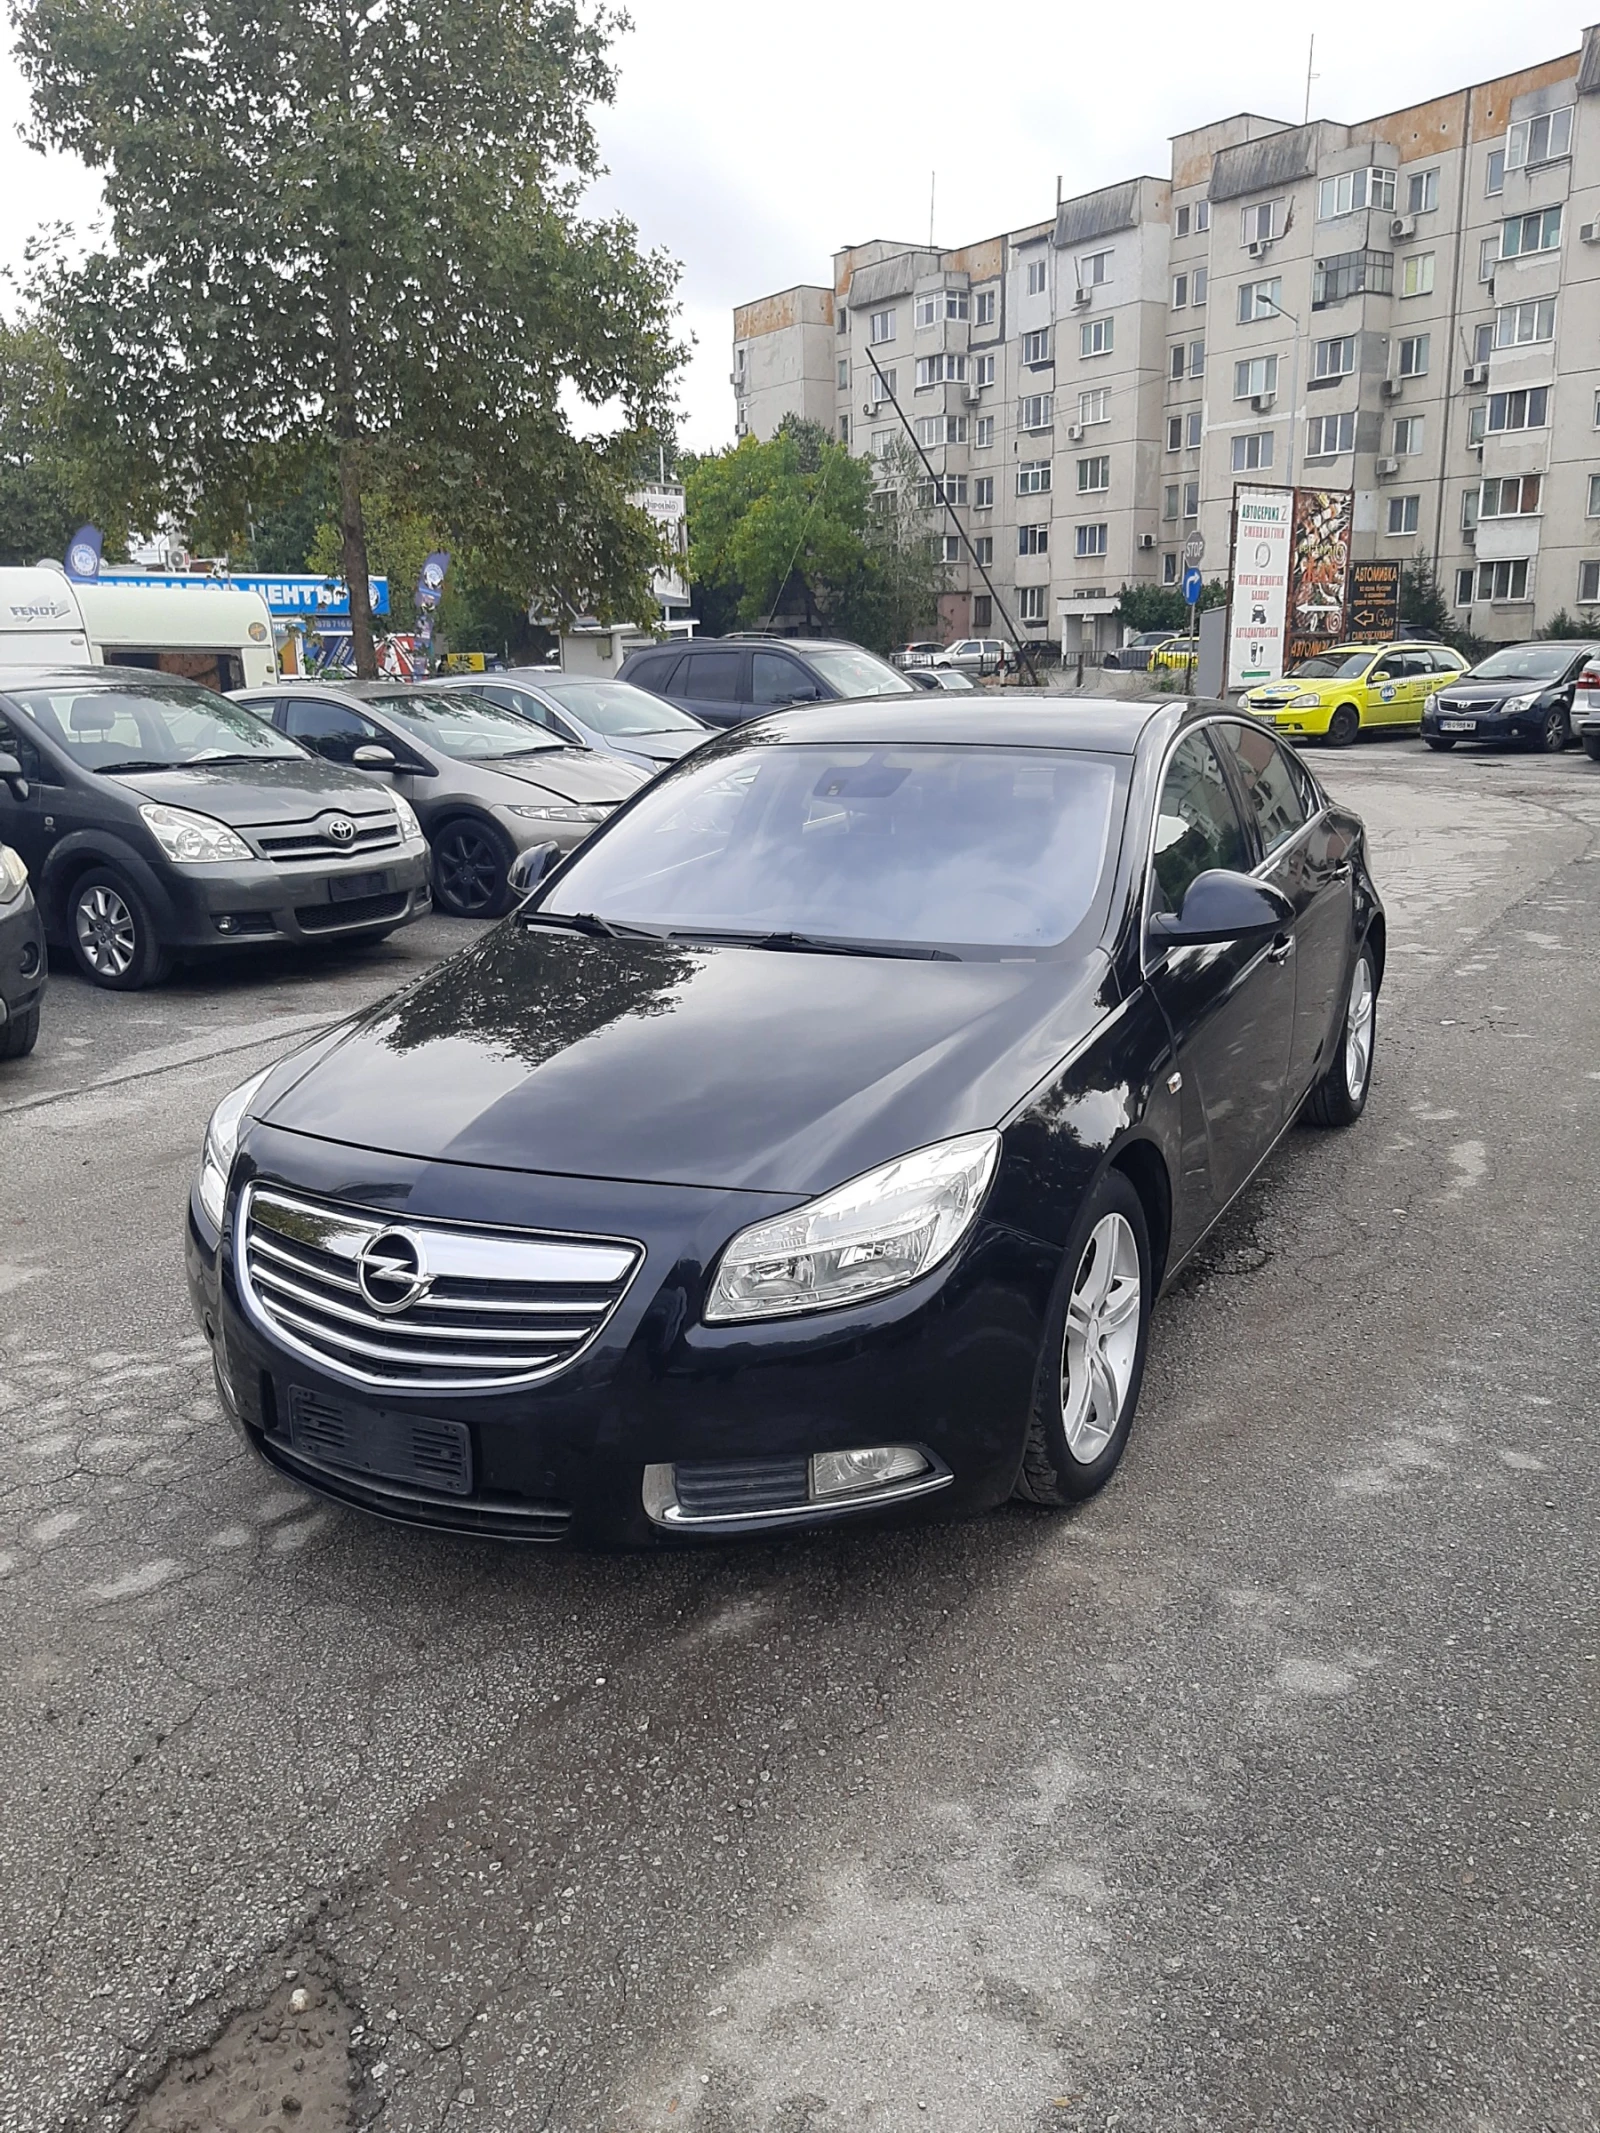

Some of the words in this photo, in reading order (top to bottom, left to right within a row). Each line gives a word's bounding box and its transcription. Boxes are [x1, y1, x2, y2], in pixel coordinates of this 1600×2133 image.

[1242, 504, 1279, 521] АВТОСЕРВИЗ
[1186, 541, 1204, 557] STOP
[1354, 566, 1397, 582] АВТОМИВКА
[249, 584, 348, 606] ЦЕНТЪР
[10, 606, 58, 616] FENDT
